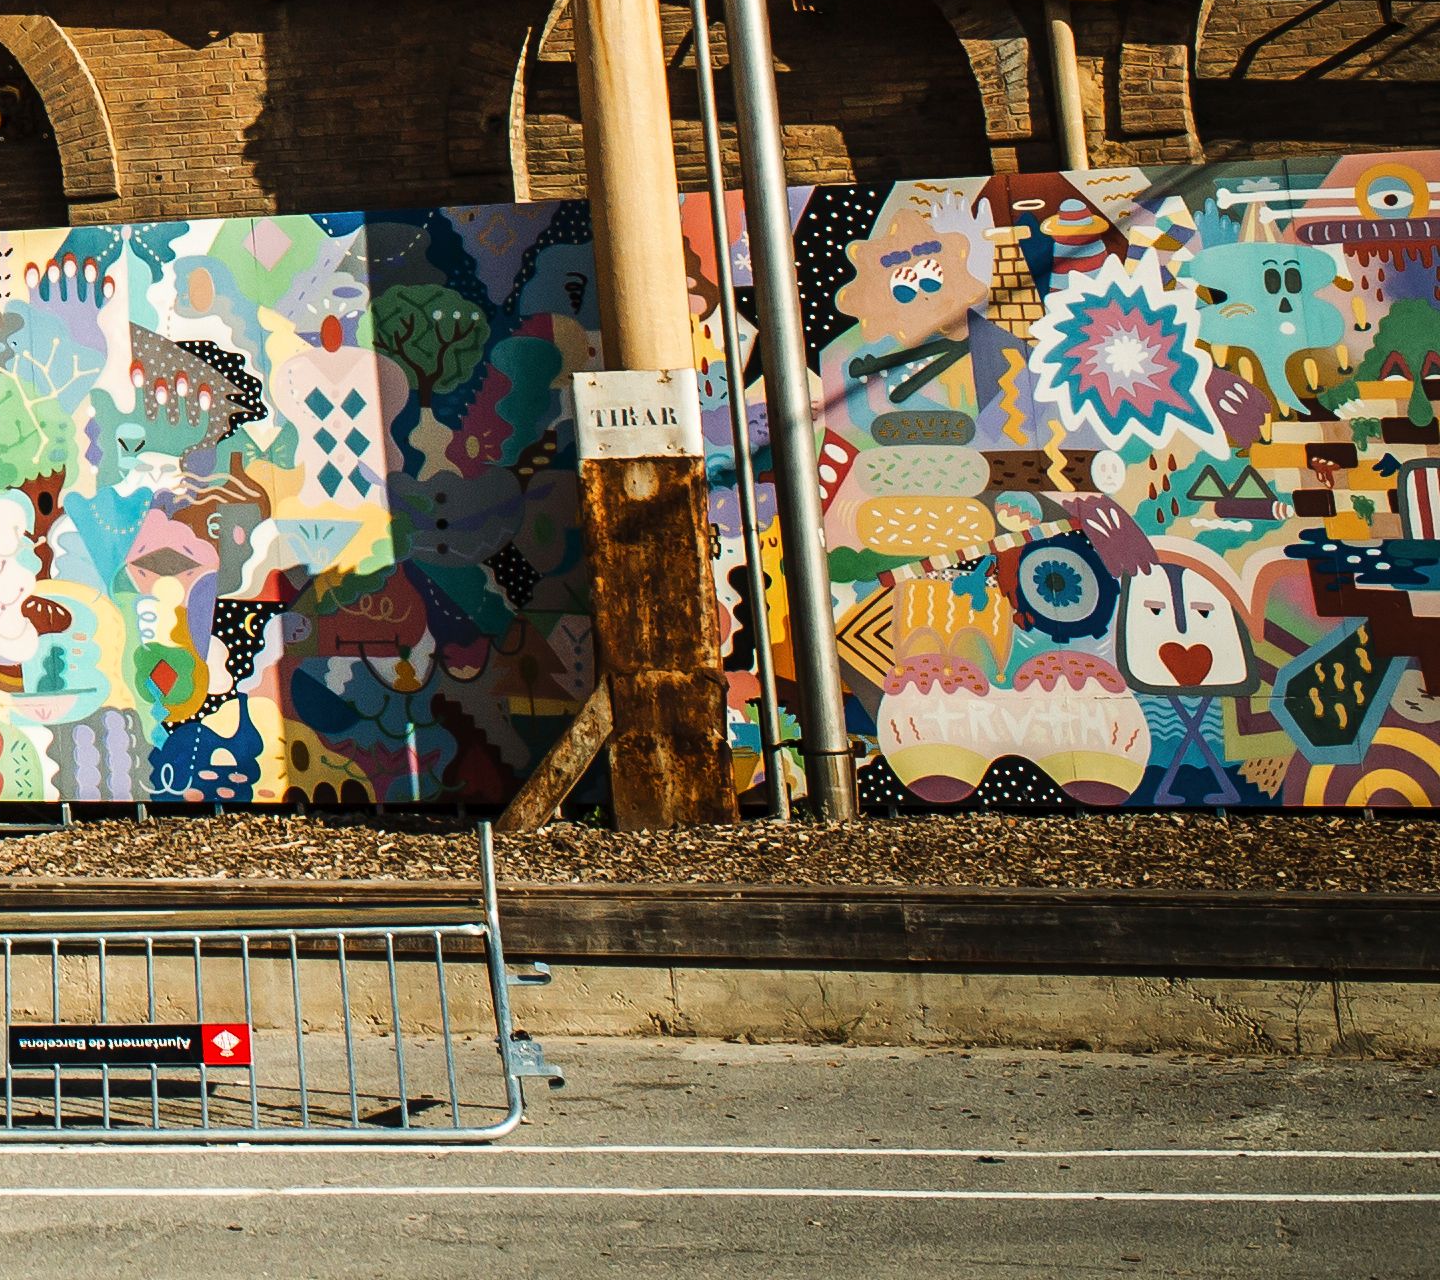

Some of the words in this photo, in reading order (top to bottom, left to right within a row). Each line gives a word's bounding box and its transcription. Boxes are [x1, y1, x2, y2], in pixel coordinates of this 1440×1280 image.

[590, 406, 678, 428] TIRAR
[18, 1037, 87, 1050] Barcelona
[88, 1038, 106, 1050] de
[109, 1036, 191, 1050] Ajuntament
